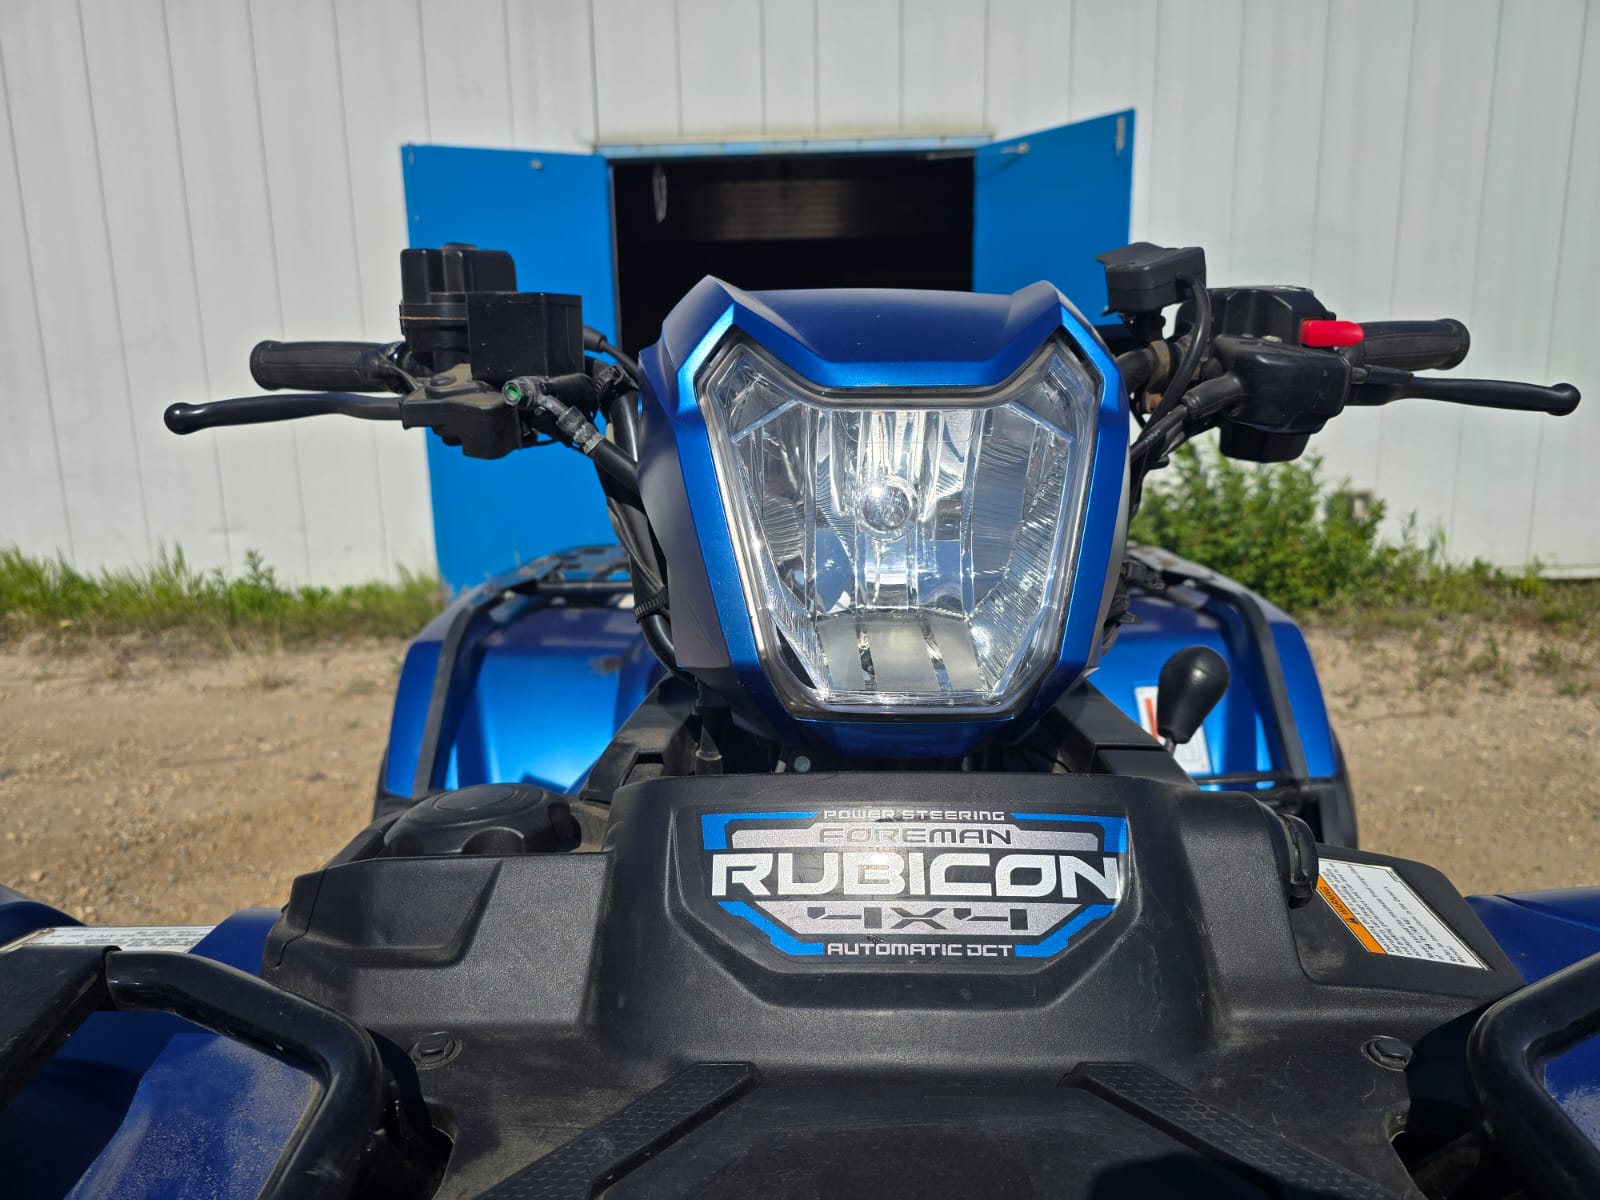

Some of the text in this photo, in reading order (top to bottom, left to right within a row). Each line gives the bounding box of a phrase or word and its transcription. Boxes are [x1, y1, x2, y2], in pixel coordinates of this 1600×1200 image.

[823, 810, 1006, 821] POWER STEERING
[818, 827, 1012, 846] FOREMAN
[711, 852, 1121, 899] RUBICON
[1317, 886, 1350, 915] WARNING
[827, 943, 1013, 958] AUTOMATIC DCT
